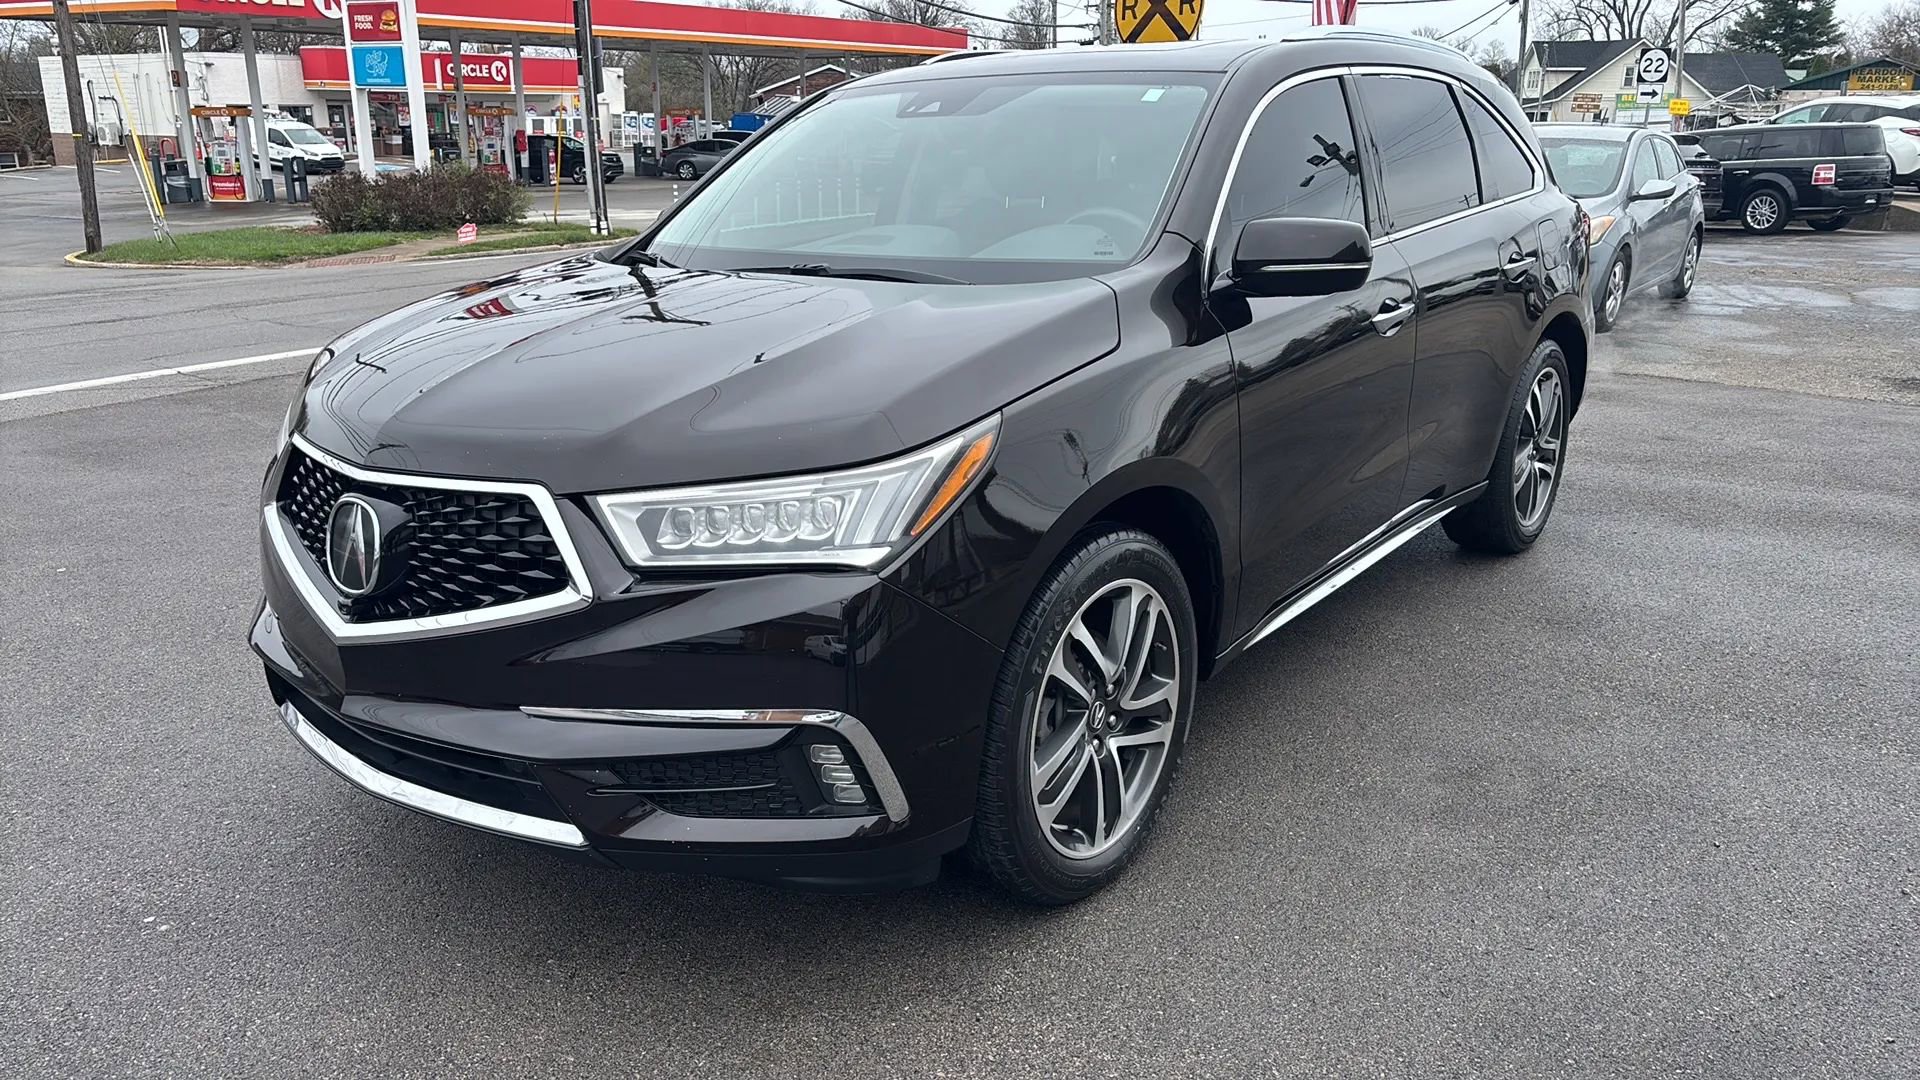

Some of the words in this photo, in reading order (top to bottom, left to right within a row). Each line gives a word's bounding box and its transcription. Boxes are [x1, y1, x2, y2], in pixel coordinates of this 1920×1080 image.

[1121, 0, 1138, 20] R
[446, 63, 490, 77] CRCLE
[1642, 58, 1665, 73] 22
